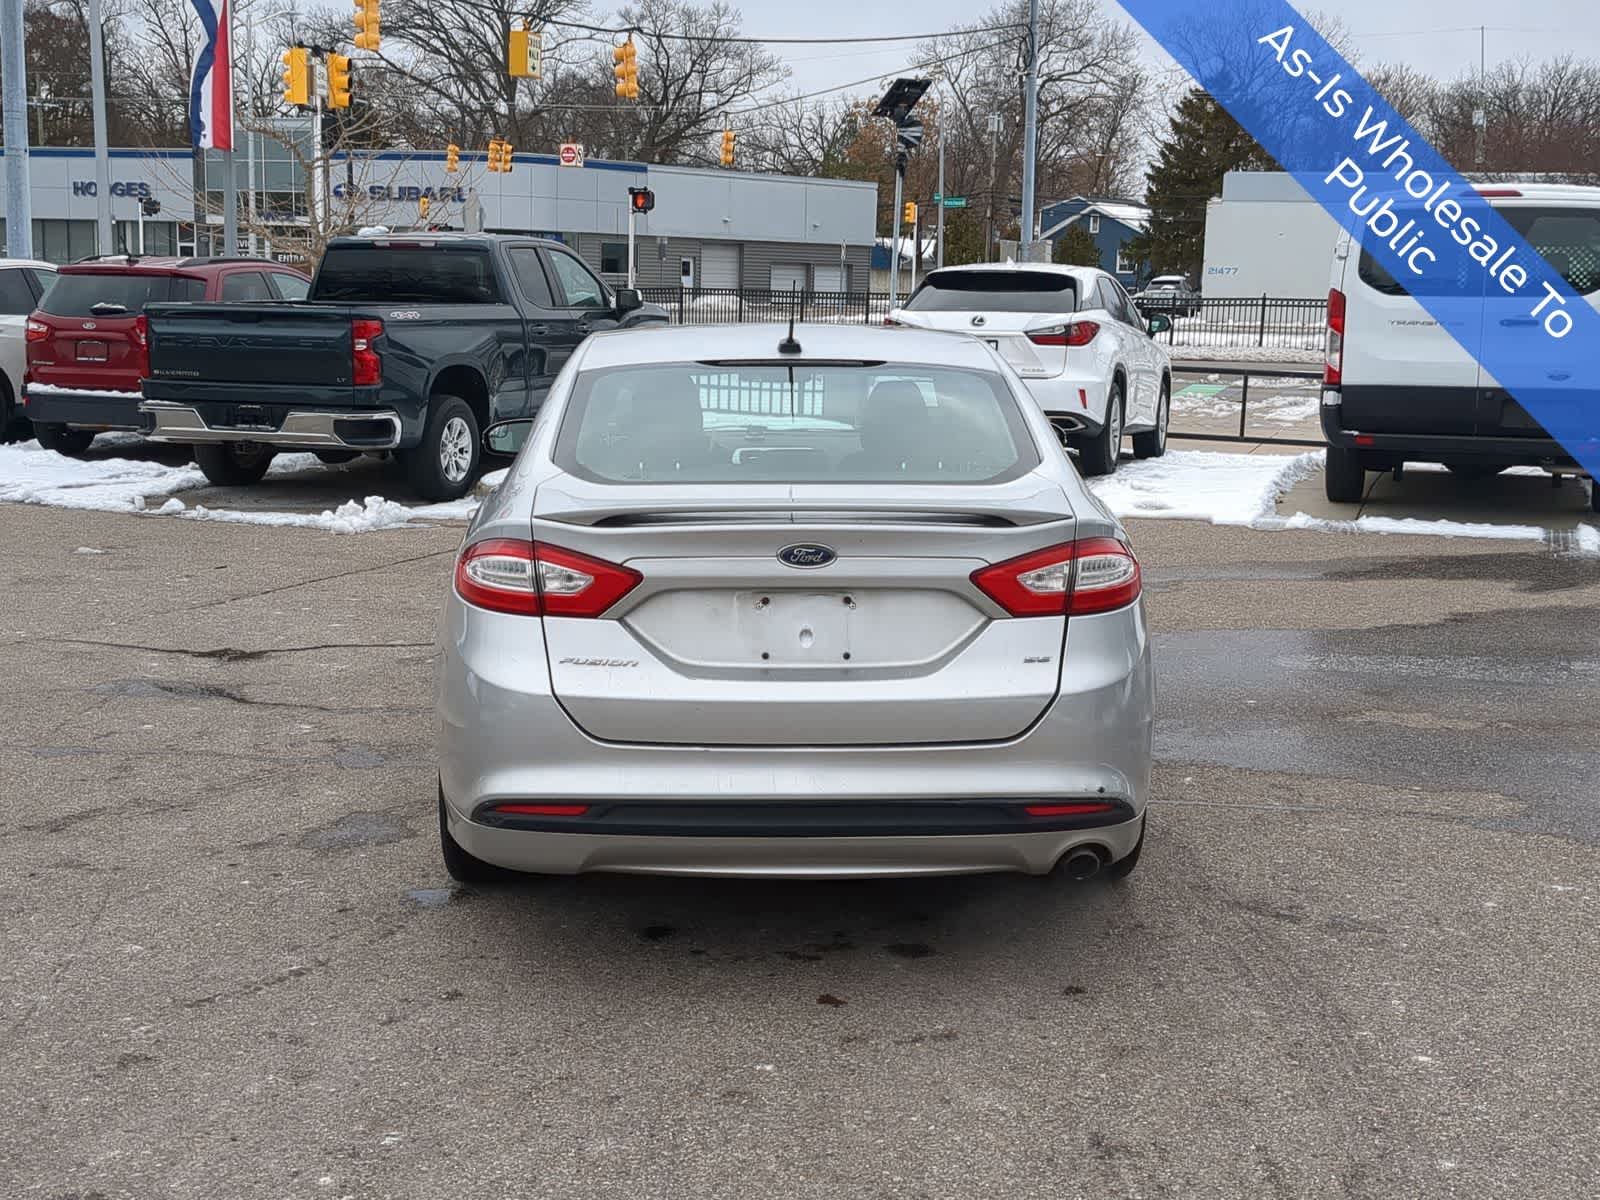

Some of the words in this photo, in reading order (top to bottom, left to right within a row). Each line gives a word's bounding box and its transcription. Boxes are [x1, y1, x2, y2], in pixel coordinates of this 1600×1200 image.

[73, 181, 151, 197] HOGES
[278, 253, 305, 264] ENTRA
[1207, 266, 1239, 276] 21477
[790, 547, 824, 562] Ford
[559, 657, 640, 667] FUSION
